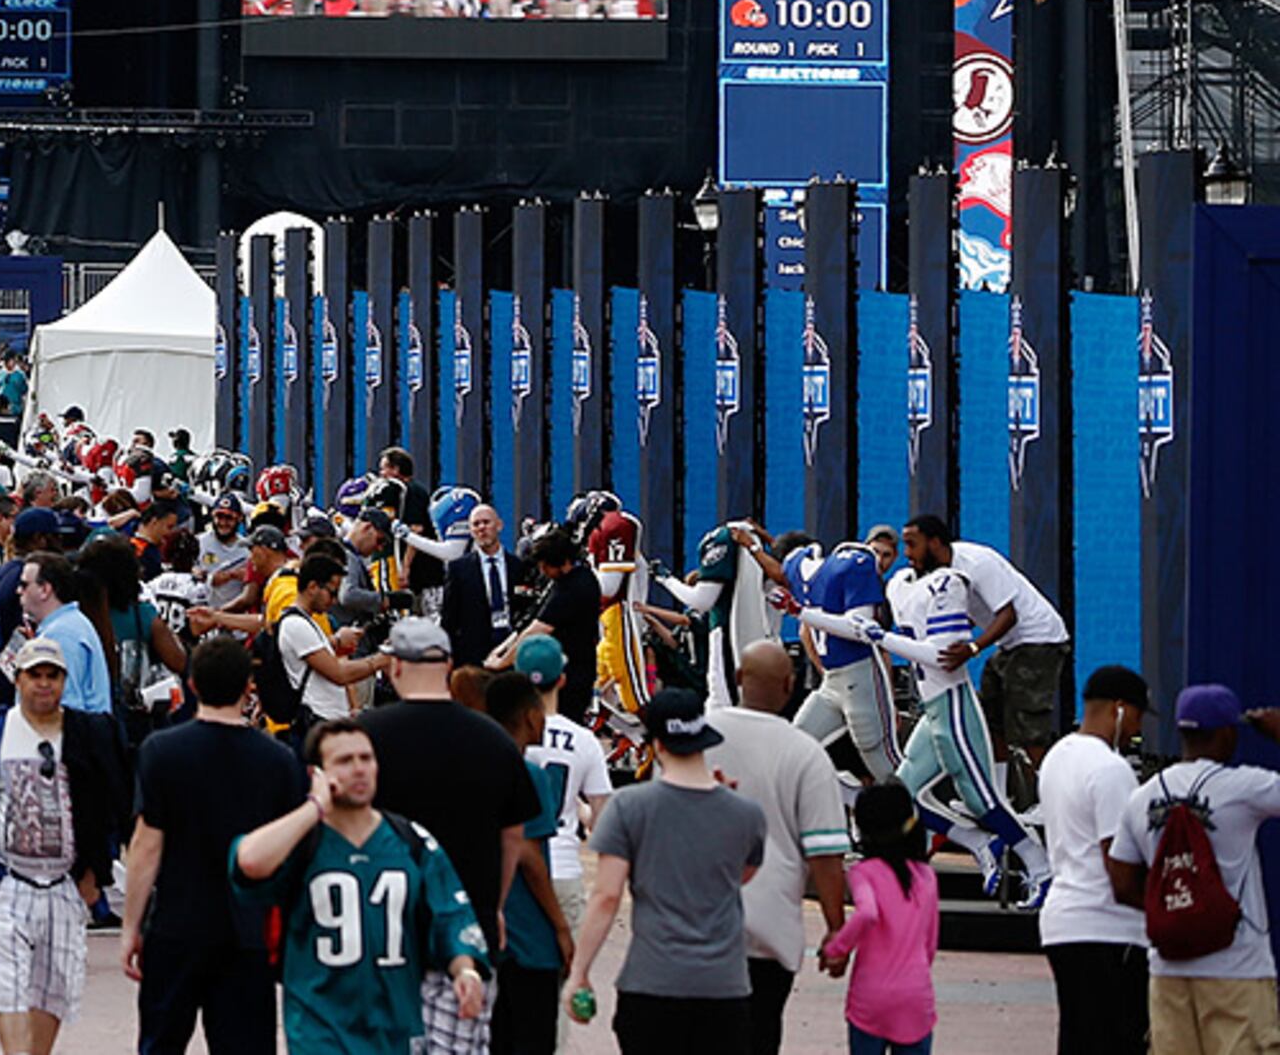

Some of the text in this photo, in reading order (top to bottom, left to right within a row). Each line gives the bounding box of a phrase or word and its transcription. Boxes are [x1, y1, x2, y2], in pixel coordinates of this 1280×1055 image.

[775, 0, 872, 28] 10:00
[732, 42, 864, 56] ROUND 1 PICK 1
[0, 56, 29, 68] PICK
[778, 237, 805, 249] Chic
[608, 544, 625, 561] 17
[547, 728, 575, 751] TZ
[308, 870, 408, 968] 91
